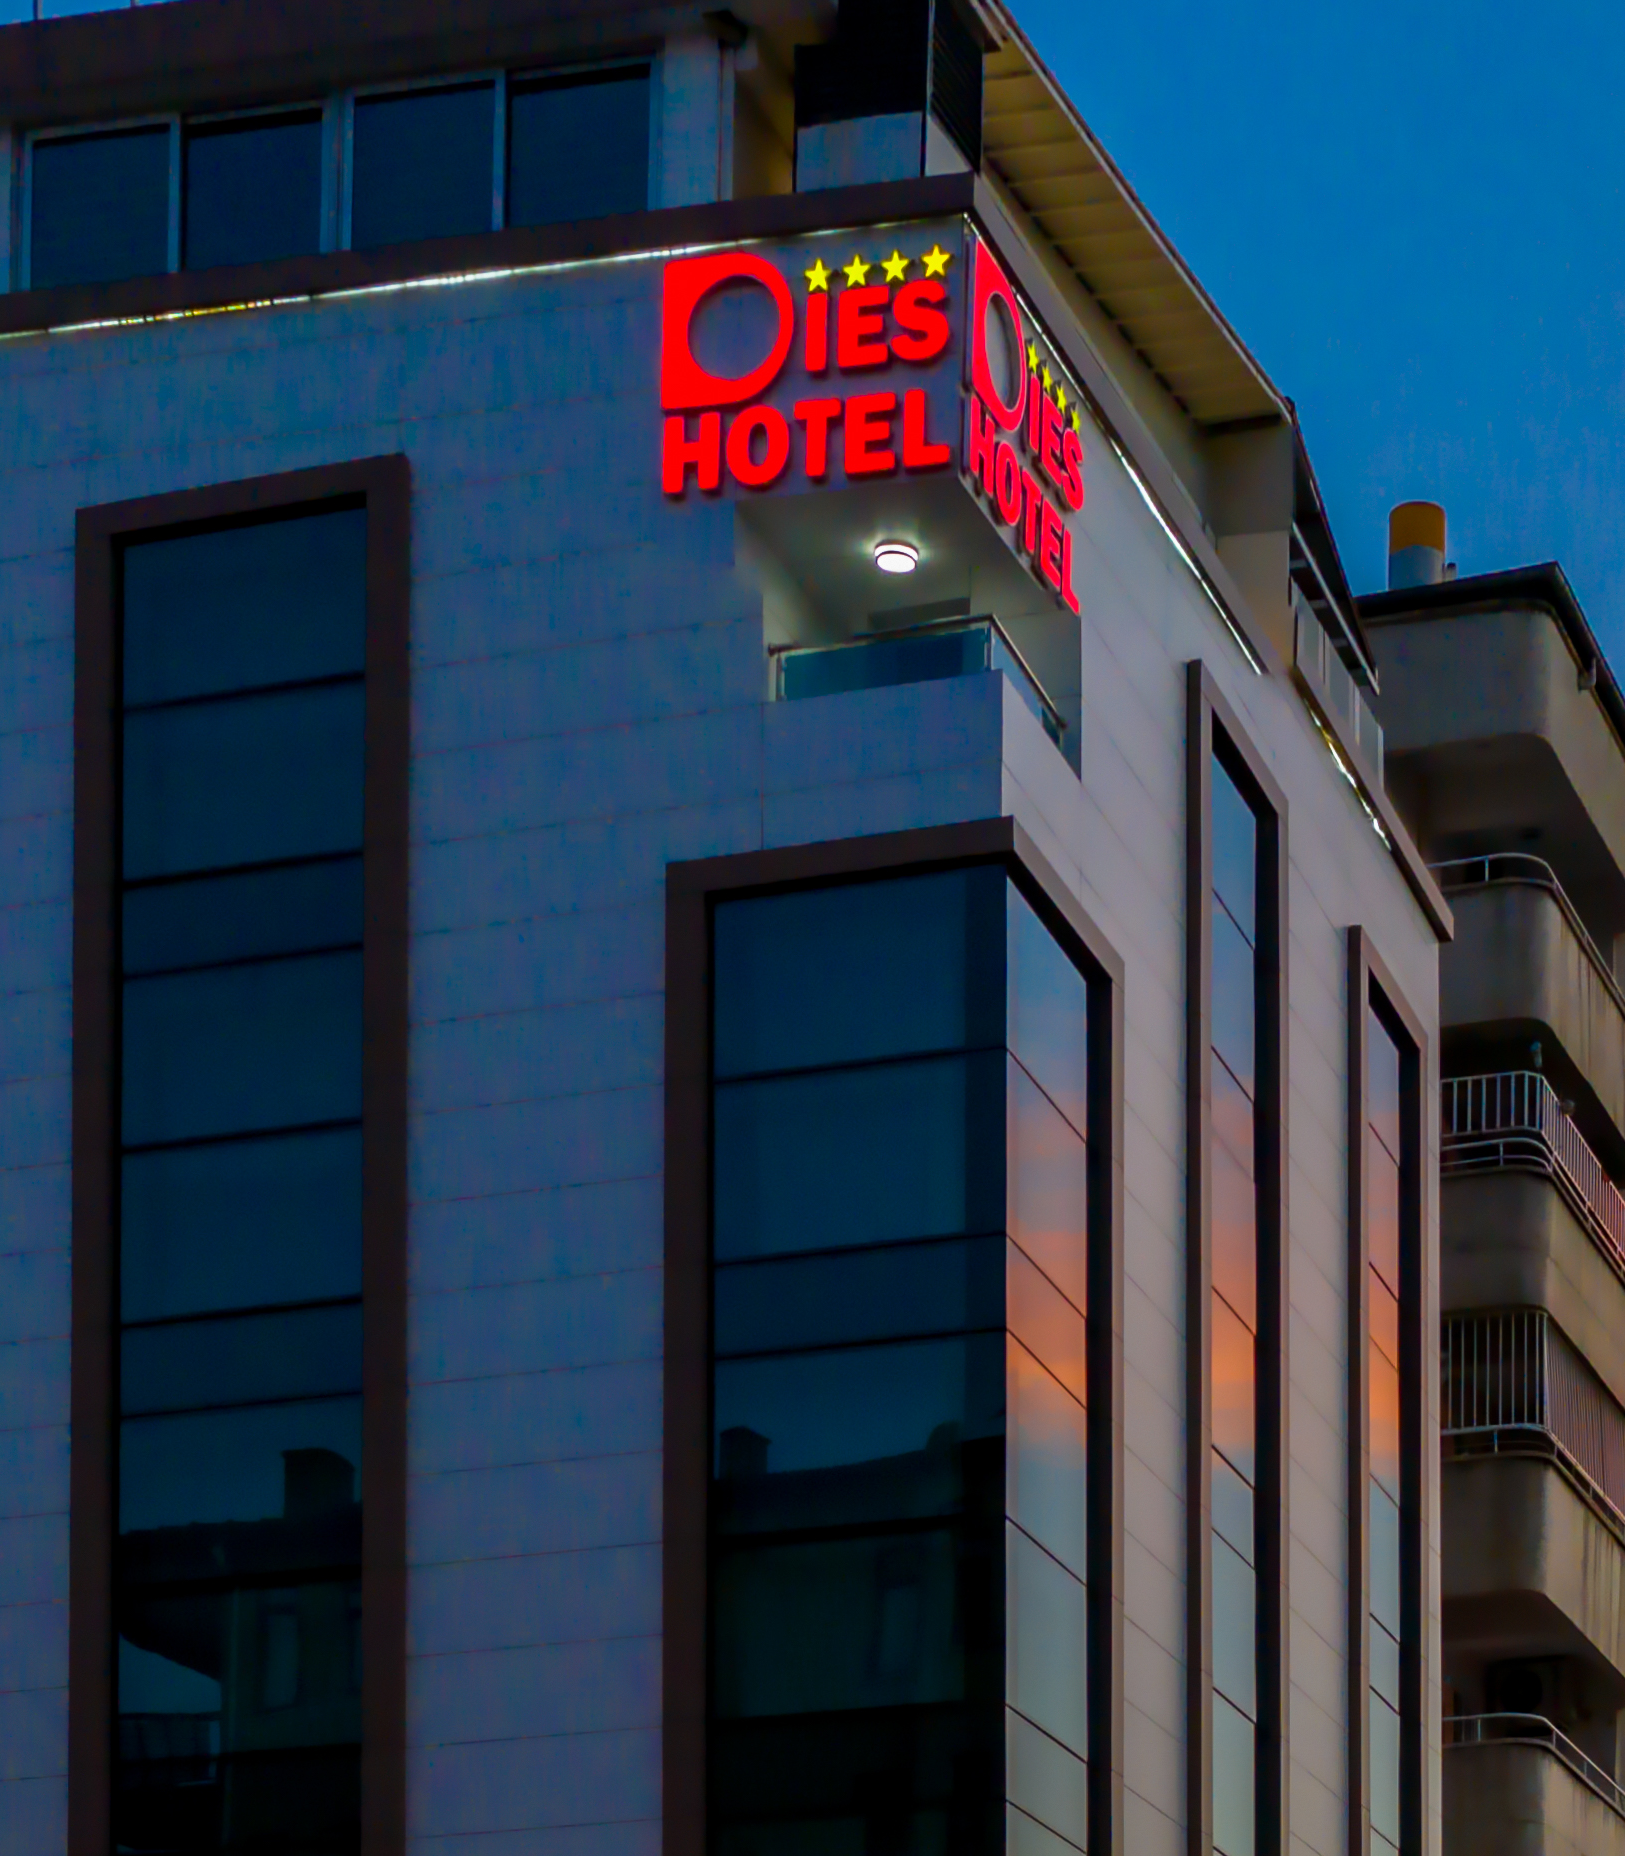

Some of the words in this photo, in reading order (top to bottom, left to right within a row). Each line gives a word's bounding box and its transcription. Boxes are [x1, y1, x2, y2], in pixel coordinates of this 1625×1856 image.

[661, 252, 950, 411] DIES
[662, 389, 951, 494] HOTEL
[970, 395, 1080, 615] HOTEL
